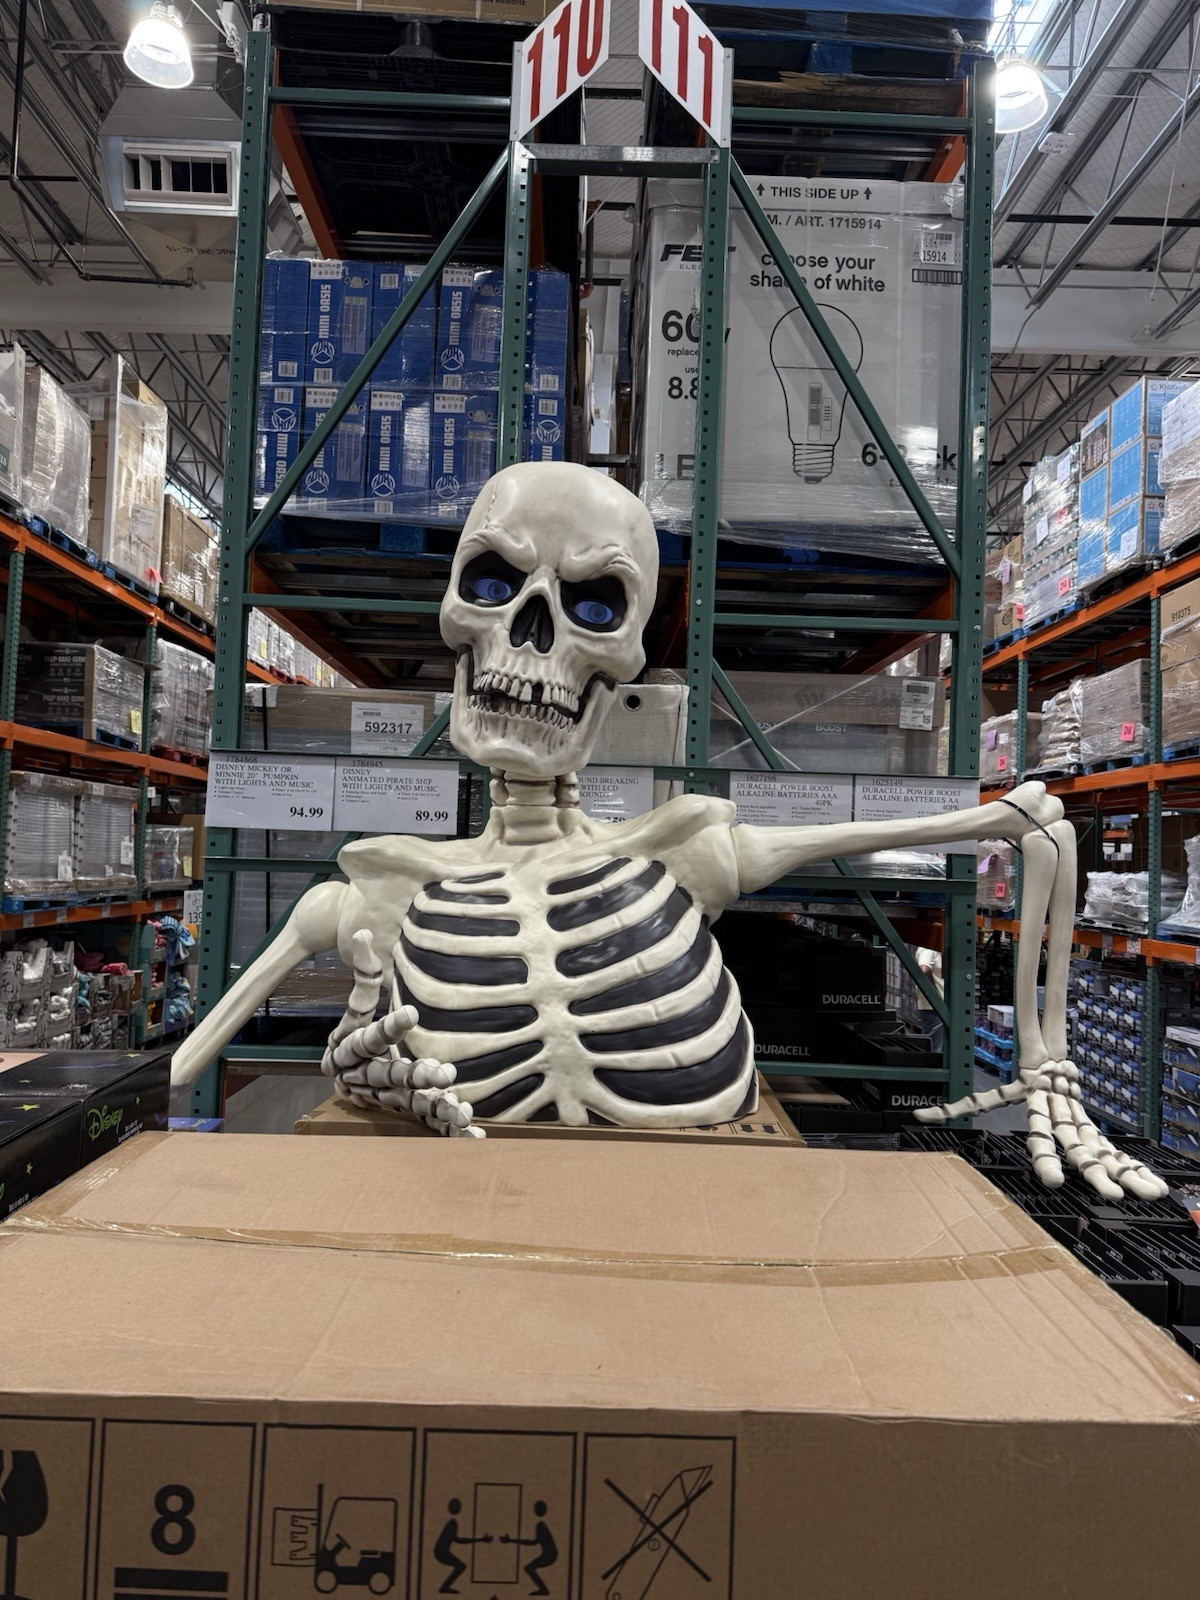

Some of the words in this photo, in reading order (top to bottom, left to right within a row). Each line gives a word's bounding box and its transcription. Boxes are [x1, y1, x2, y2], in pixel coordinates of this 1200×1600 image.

[527, 0, 604, 122] 110
[651, 0, 713, 128] 111
[770, 187, 801, 198] THIS
[805, 188, 836, 199] SIDE
[840, 189, 859, 200] UP
[795, 215, 824, 227] ART.
[829, 217, 882, 229] 1715914
[923, 250, 947, 262] 15914
[761, 253, 829, 268] cose
[835, 256, 876, 274] your
[750, 271, 807, 288] sha
[814, 273, 832, 290] of
[835, 274, 886, 292] white
[320, 284, 332, 312] OASIS
[450, 291, 463, 319] OASIS
[319, 315, 330, 339] MINI
[448, 321, 461, 346] MINI
[667, 347, 700, 357] replace
[684, 367, 699, 375] use
[380, 415, 392, 444] OASIS
[443, 418, 455, 447] OASIS
[276, 432, 289, 458] MINI
[379, 446, 391, 471] MINI
[443, 449, 455, 474] MINI
[274, 459, 287, 489] OASI
[1171, 605, 1191, 622] 910375
[364, 721, 413, 734] 592317
[815, 723, 847, 733] BOOST
[215, 763, 246, 771] DISNEY
[247, 765, 279, 773] MICKEY
[352, 760, 383, 768] 1784945
[215, 771, 245, 779] MINNIE
[263, 773, 299, 781] PUMPKIN
[342, 775, 385, 783] ANIMATED
[386, 777, 414, 785] PIRATE
[577, 776, 598, 784] OUND
[599, 777, 640, 785] BREAKING
[746, 774, 777, 782] 1627198
[215, 778, 236, 786] WITH
[238, 779, 267, 787] LIGHTS
[288, 781, 314, 789] MUSIC
[342, 782, 363, 790] WITH
[364, 783, 393, 791] LIGHTS
[394, 784, 412, 792] AND
[413, 785, 439, 793] MUSIC
[737, 782, 779, 791] DURACELL
[780, 784, 808, 792] POWER
[871, 779, 903, 787] 1625149
[736, 790, 776, 798] ALKALINE
[777, 791, 819, 799] BATTERIES
[820, 792, 838, 800] AAA
[862, 786, 904, 795] DURACELL
[906, 788, 934, 796] POWER
[936, 789, 962, 797] BOOST
[815, 799, 833, 807] 40PK
[862, 794, 901, 802] ALKALINE
[903, 795, 946, 804] BATTERIES
[289, 806, 324, 818] 94.99
[415, 810, 449, 822] 89.99
[822, 994, 881, 1005] DURACELL
[755, 1044, 811, 1056] DURACELL
[891, 1095, 943, 1107] DURACE
[150, 1484, 196, 1555] 8
